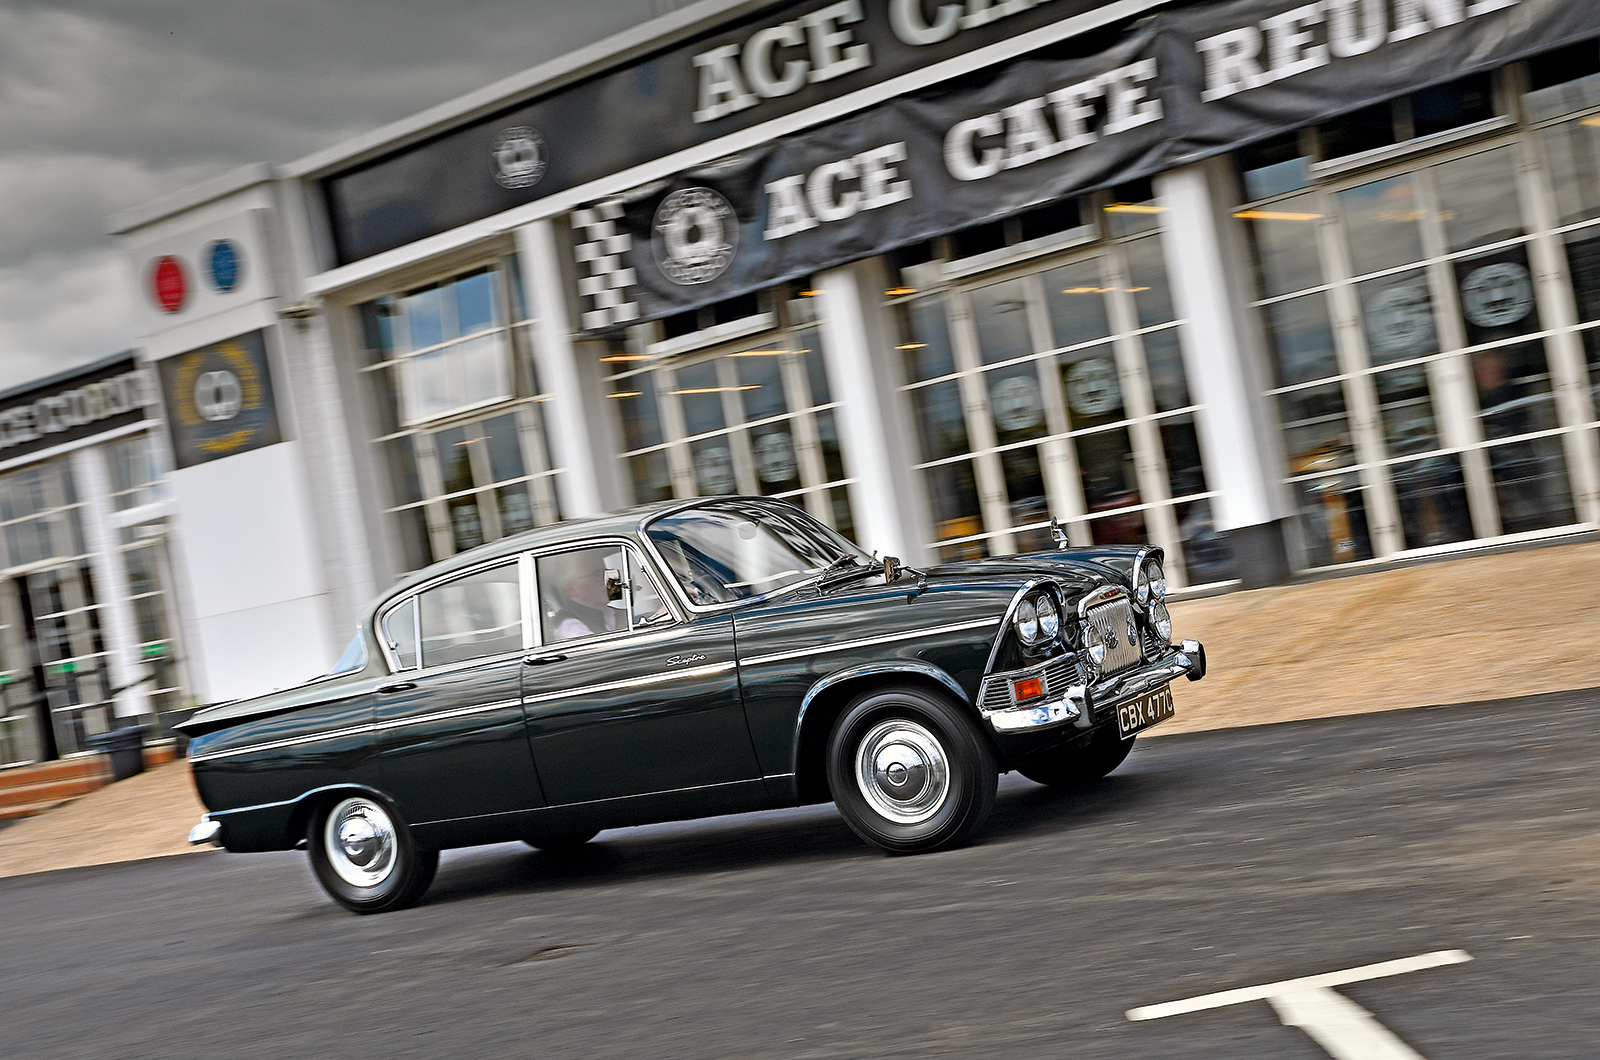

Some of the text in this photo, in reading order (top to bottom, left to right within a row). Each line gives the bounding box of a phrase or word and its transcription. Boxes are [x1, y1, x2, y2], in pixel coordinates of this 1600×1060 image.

[692, 0, 873, 124] ACE
[763, 141, 913, 241] ACE
[943, 57, 1163, 182] CAFE
[1196, 0, 1521, 103] REUN
[665, 653, 707, 667] Sceptre
[1119, 688, 1174, 732] CBX 477C
